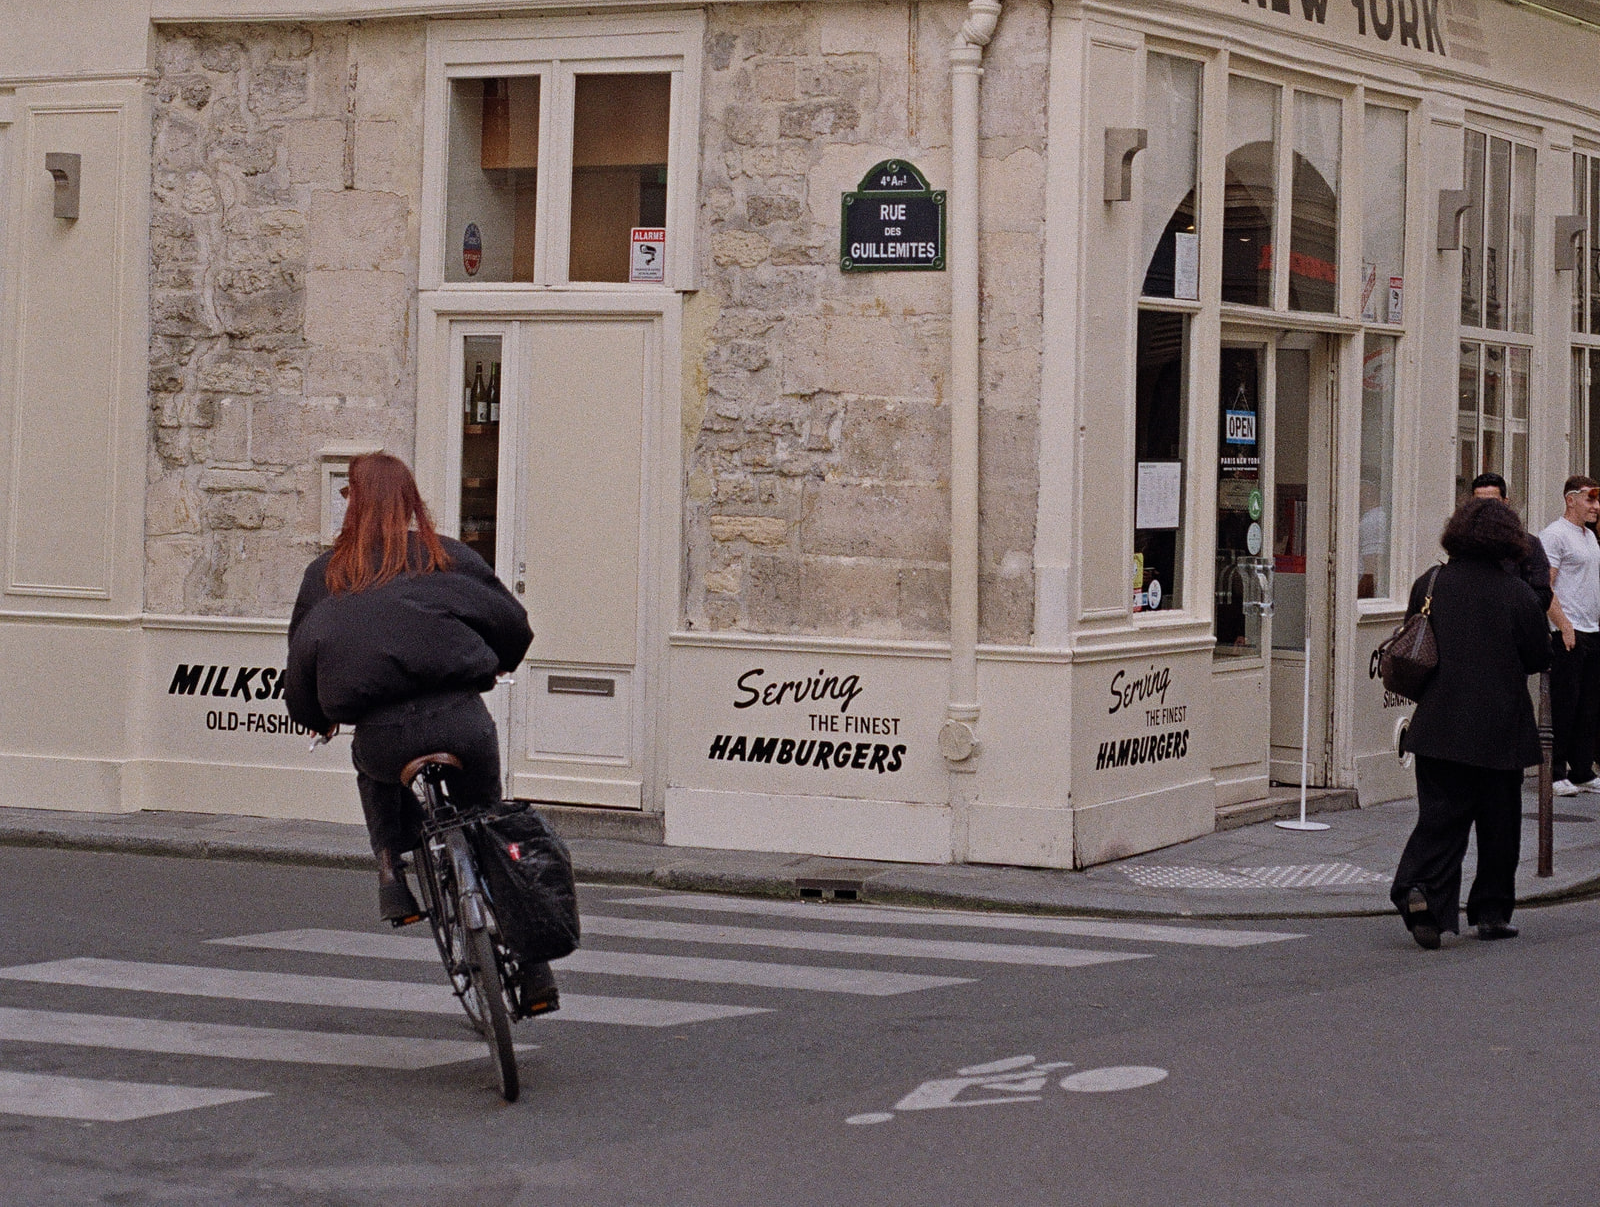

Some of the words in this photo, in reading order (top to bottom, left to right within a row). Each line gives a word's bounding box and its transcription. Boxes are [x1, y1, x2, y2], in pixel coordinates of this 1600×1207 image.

[880, 204, 906, 221] RUE
[634, 231, 665, 241] ALARME
[884, 227, 902, 236] DES
[851, 242, 936, 259] GUILLEMITES
[1229, 416, 1254, 438] OPEN
[1220, 457, 1236, 465] PARIS
[1236, 457, 1247, 465] NEW
[733, 668, 863, 713] Serving
[1109, 664, 1171, 714] Serving
[809, 714, 839, 732] THE
[845, 716, 901, 735] FINEST
[1146, 709, 1160, 727] THE
[1162, 705, 1187, 725] FINEST
[708, 734, 907, 774] HAMBURGERS
[1096, 729, 1189, 771] HAMBURGERS
